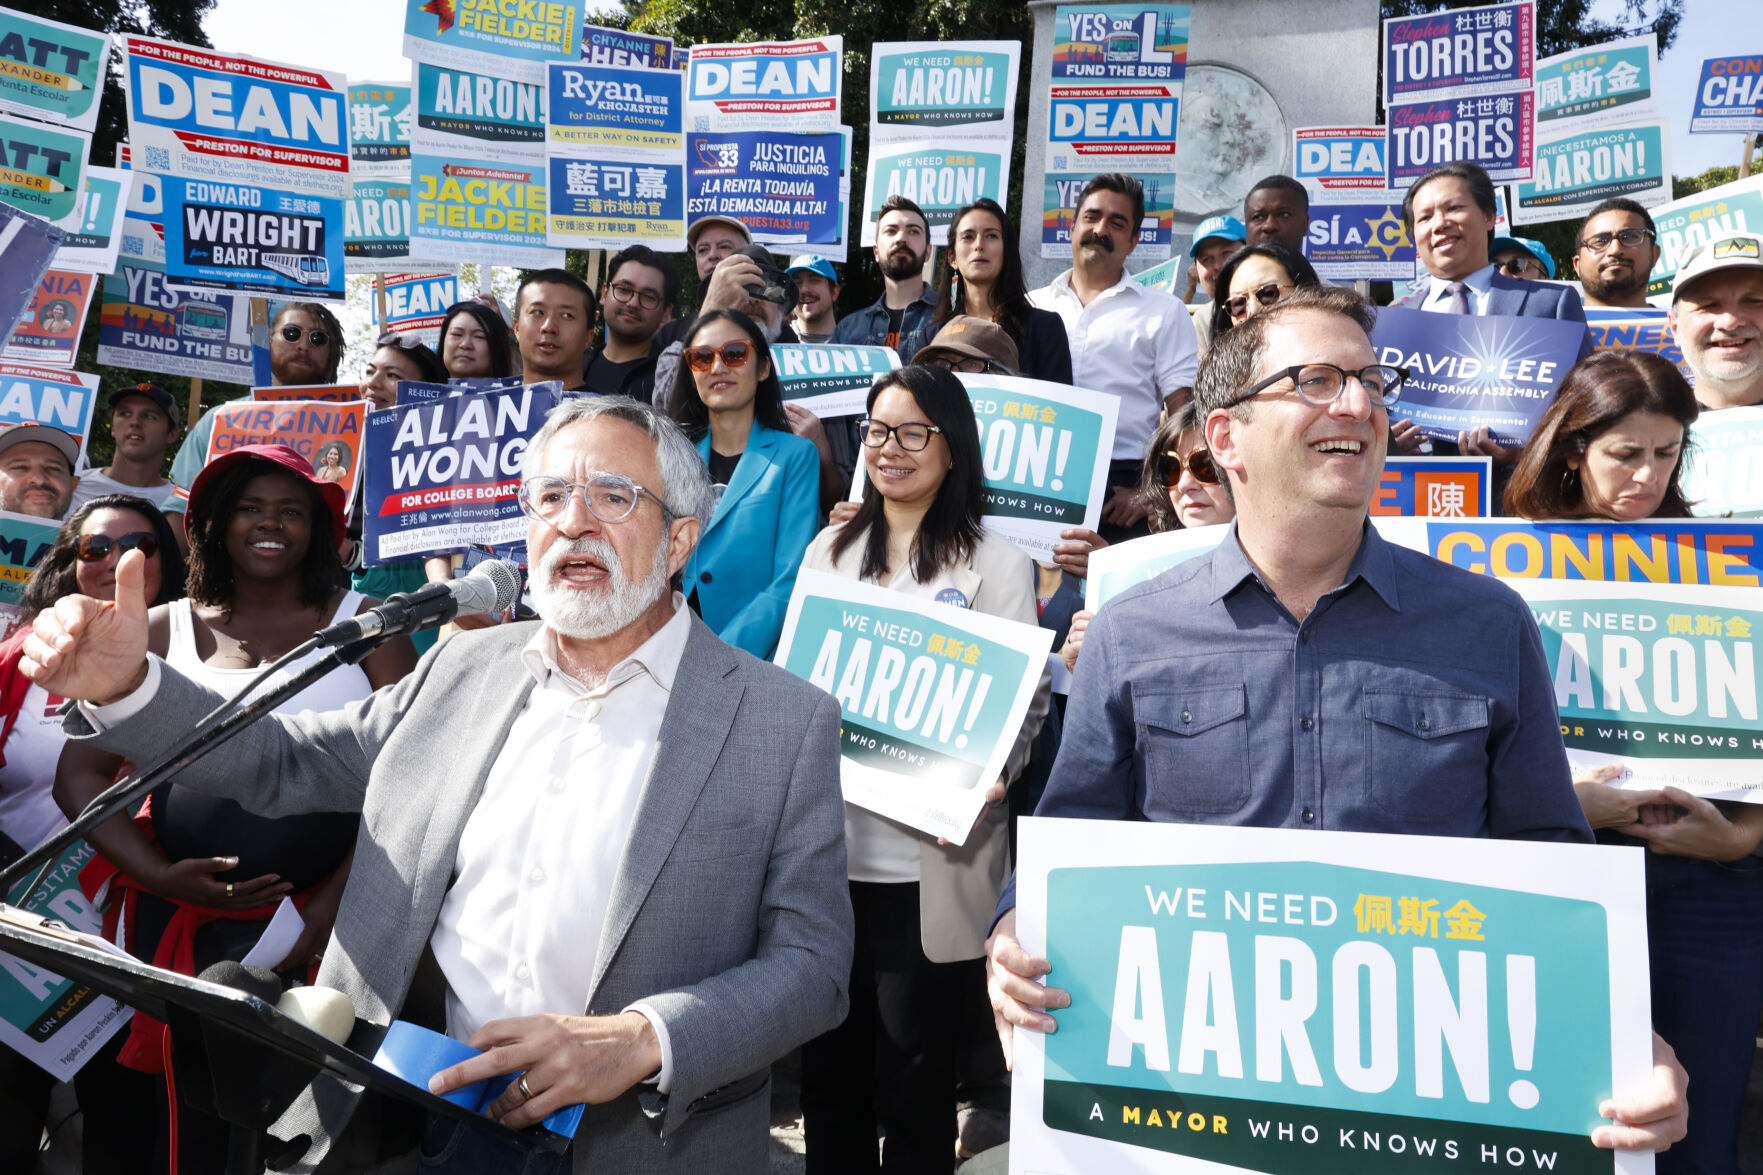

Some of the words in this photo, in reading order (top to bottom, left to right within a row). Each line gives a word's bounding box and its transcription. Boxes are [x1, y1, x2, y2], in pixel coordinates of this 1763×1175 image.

[459, 9, 562, 44] FIELDER
[1392, 19, 1450, 46] Stephen
[1455, 10, 1512, 32] 杜世衡
[494, 35, 541, 50] SUPERVISOR
[592, 33, 650, 53] CHYANNE
[1068, 13, 1106, 41] YES
[1113, 20, 1132, 31] ON
[1140, 12, 1173, 63] L
[782, 45, 818, 54] POWERFUL
[1391, 30, 1513, 83] TORRES
[139, 44, 160, 56] FOR
[162, 48, 182, 61] THE
[183, 53, 224, 70] PEOPLE,
[225, 61, 248, 72] NOT
[248, 65, 266, 76] THE
[266, 68, 319, 85] POWERFUL
[904, 57, 919, 66] WE
[923, 57, 951, 66] NEED
[1066, 64, 1105, 76] FUND
[1108, 65, 1135, 76] THE
[1138, 66, 1171, 77] BUS!
[0, 62, 61, 85] XANDER
[694, 57, 832, 96] DEAN
[30, 85, 71, 102] Escolar
[435, 72, 545, 124] AARON!
[562, 70, 645, 106] Ryan
[891, 67, 993, 106] AARON!
[138, 64, 340, 146] DEAN
[598, 100, 669, 115] KHOJASTEH
[764, 102, 781, 110] FOR
[781, 101, 831, 111] SUPERVISOR
[440, 121, 470, 130] MAYOR
[474, 124, 494, 132] WHO
[498, 125, 528, 136] KNOWS
[569, 111, 583, 120] for
[585, 112, 621, 122] District
[623, 114, 665, 127] Attorney
[1055, 102, 1173, 137] DEAN
[1393, 104, 1451, 131] Stephen
[564, 131, 599, 139] BETTER
[602, 131, 622, 140] WAY
[625, 134, 640, 143] ON
[642, 136, 677, 145] SAFETY
[1392, 117, 1514, 167] TORRES
[1627, 132, 1636, 140] A
[195, 139, 248, 155] PRESTON
[250, 147, 272, 158] FOR
[273, 150, 342, 168] SUPERVISOR
[718, 151, 738, 167] 33
[753, 142, 826, 163] JUSTICIA
[1129, 144, 1171, 152] SUPERVISOR
[749, 161, 775, 173] PARA
[777, 163, 829, 176] INQUILINOS
[897, 158, 912, 167] WE
[915, 157, 943, 166] NEED
[1535, 140, 1646, 193] AARON!
[456, 167, 486, 177] ¡Juntos
[486, 170, 525, 181] Adelante!
[566, 161, 668, 199] 藍可嘉
[12, 187, 53, 205] Escolar
[185, 181, 261, 207] EDWARD
[353, 188, 384, 198] NEED
[417, 174, 546, 211] JACKIE
[701, 179, 720, 195] ¡LA
[722, 179, 761, 193] RENTA
[765, 179, 815, 196] TODAVÍA
[1563, 193, 1577, 201] CON
[1577, 185, 1620, 198] EXPERIENCIA
[1626, 179, 1658, 191] CORAZÓN
[688, 196, 718, 212] ESTÁ
[720, 198, 790, 215] DEMASIADA
[793, 201, 827, 215] ALTA!
[186, 207, 323, 251] WRIGHT
[417, 202, 547, 235] FIELDER
[441, 229, 462, 239] FOR
[463, 231, 523, 243] SUPERVISOR
[1308, 215, 1341, 246] SÍ
[1344, 227, 1363, 245] A
[1376, 220, 1401, 246] C
[212, 246, 259, 266] BART
[124, 266, 179, 309] YES
[374, 280, 454, 323] DEAN
[122, 331, 180, 351] FUND
[183, 340, 221, 358] THE
[16, 368, 30, 376] THE
[30, 370, 72, 382] POWERFUL
[1380, 347, 1482, 379] DAVID
[1499, 358, 1557, 384] LEE
[408, 388, 441, 398] RE-ELECT
[783, 382, 808, 392] WHO
[812, 379, 850, 388] KNOWS
[1403, 378, 1478, 396] CALIFORNIA
[1482, 387, 1550, 400] ASSEMBLY
[224, 409, 358, 435] VIRGINIA
[372, 413, 398, 426] RE-ELECT
[392, 390, 533, 452] ALAN
[1003, 401, 1057, 424] 佩斯金
[1402, 408, 1413, 416] an
[1415, 410, 1456, 423] Educator
[215, 434, 313, 456] CHEUNG
[391, 437, 530, 490] WONG
[401, 494, 423, 509] FOR
[424, 488, 473, 505] COLLEGE
[476, 483, 515, 499] BOARD
[1427, 481, 1466, 517] 陳
[431, 504, 518, 521] www.alanwong.com
[1034, 502, 1065, 517] HOW
[421, 528, 436, 538] Alan
[437, 527, 458, 539] Wong
[473, 520, 500, 535] College
[501, 518, 520, 530] Board
[385, 542, 409, 555] Financial
[456, 532, 491, 545] available
[1017, 536, 1043, 550] available
[1436, 531, 1760, 587] CONNIE
[842, 610, 870, 633] WE
[873, 621, 923, 648] NEED
[1538, 610, 1573, 628] WE
[1582, 611, 1657, 632] NEED
[1666, 613, 1752, 638] 佩斯金
[926, 632, 982, 667] 佩斯金
[808, 628, 993, 750] AARON!
[849, 731, 877, 750] WHO
[880, 743, 926, 767] KNOWS
[1597, 727, 1646, 741] WHO
[1658, 730, 1739, 749] KNOWS
[1144, 884, 1207, 919] WE
[1224, 889, 1338, 927] NEED
[1353, 893, 1487, 941] 佩斯金
[39, 1015, 58, 1034] UN
[1106, 925, 1540, 1110] AARON!
[1089, 1102, 1104, 1122] A
[1122, 1105, 1228, 1135] MAYOR
[1248, 1118, 1319, 1143] WHO
[1339, 1128, 1460, 1159] KNOWS
[1481, 1143, 1558, 1170] HOW
